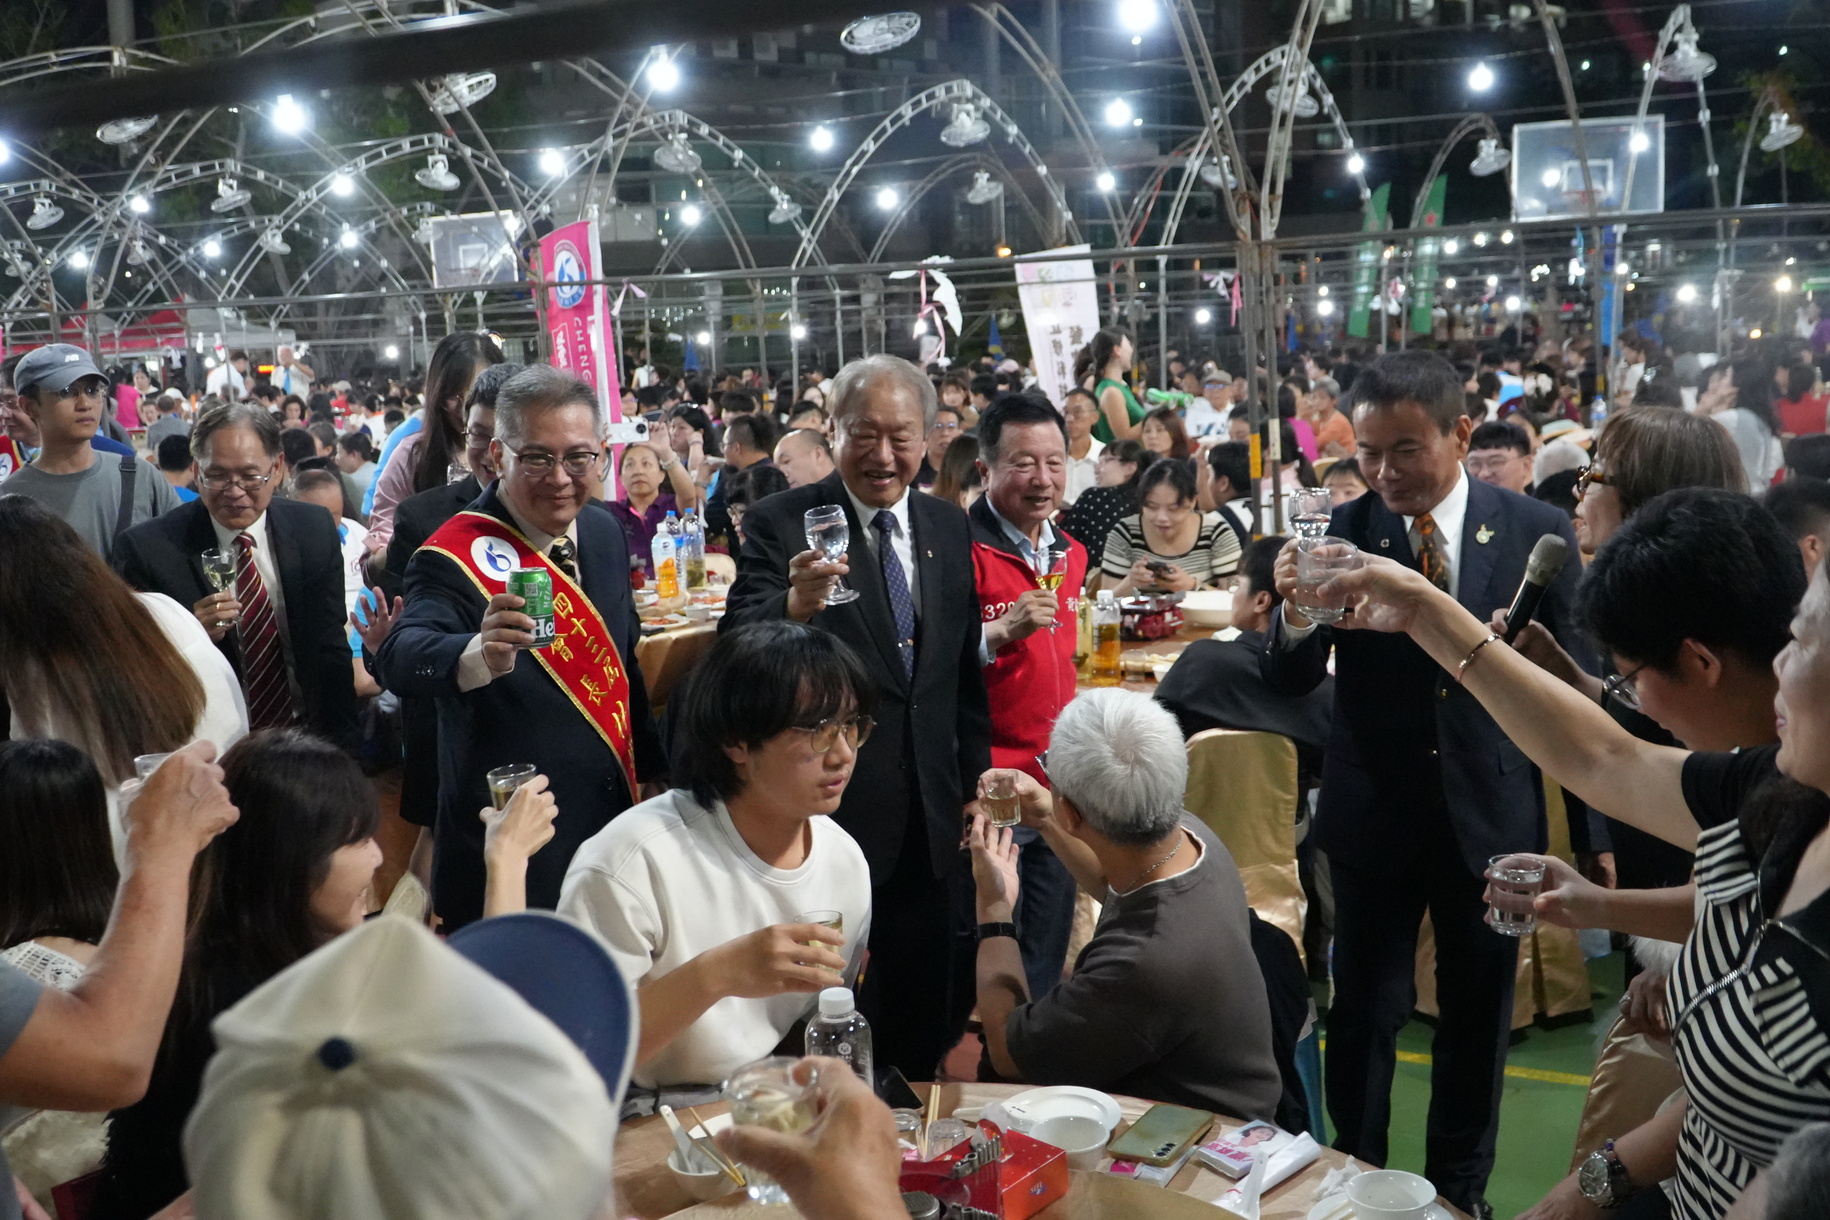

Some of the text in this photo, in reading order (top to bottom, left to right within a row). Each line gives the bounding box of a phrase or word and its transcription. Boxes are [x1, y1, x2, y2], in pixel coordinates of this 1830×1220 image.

[574, 316, 593, 382] CHENG
[550, 633, 608, 707] 會長
[553, 591, 620, 690] 四十三屆
